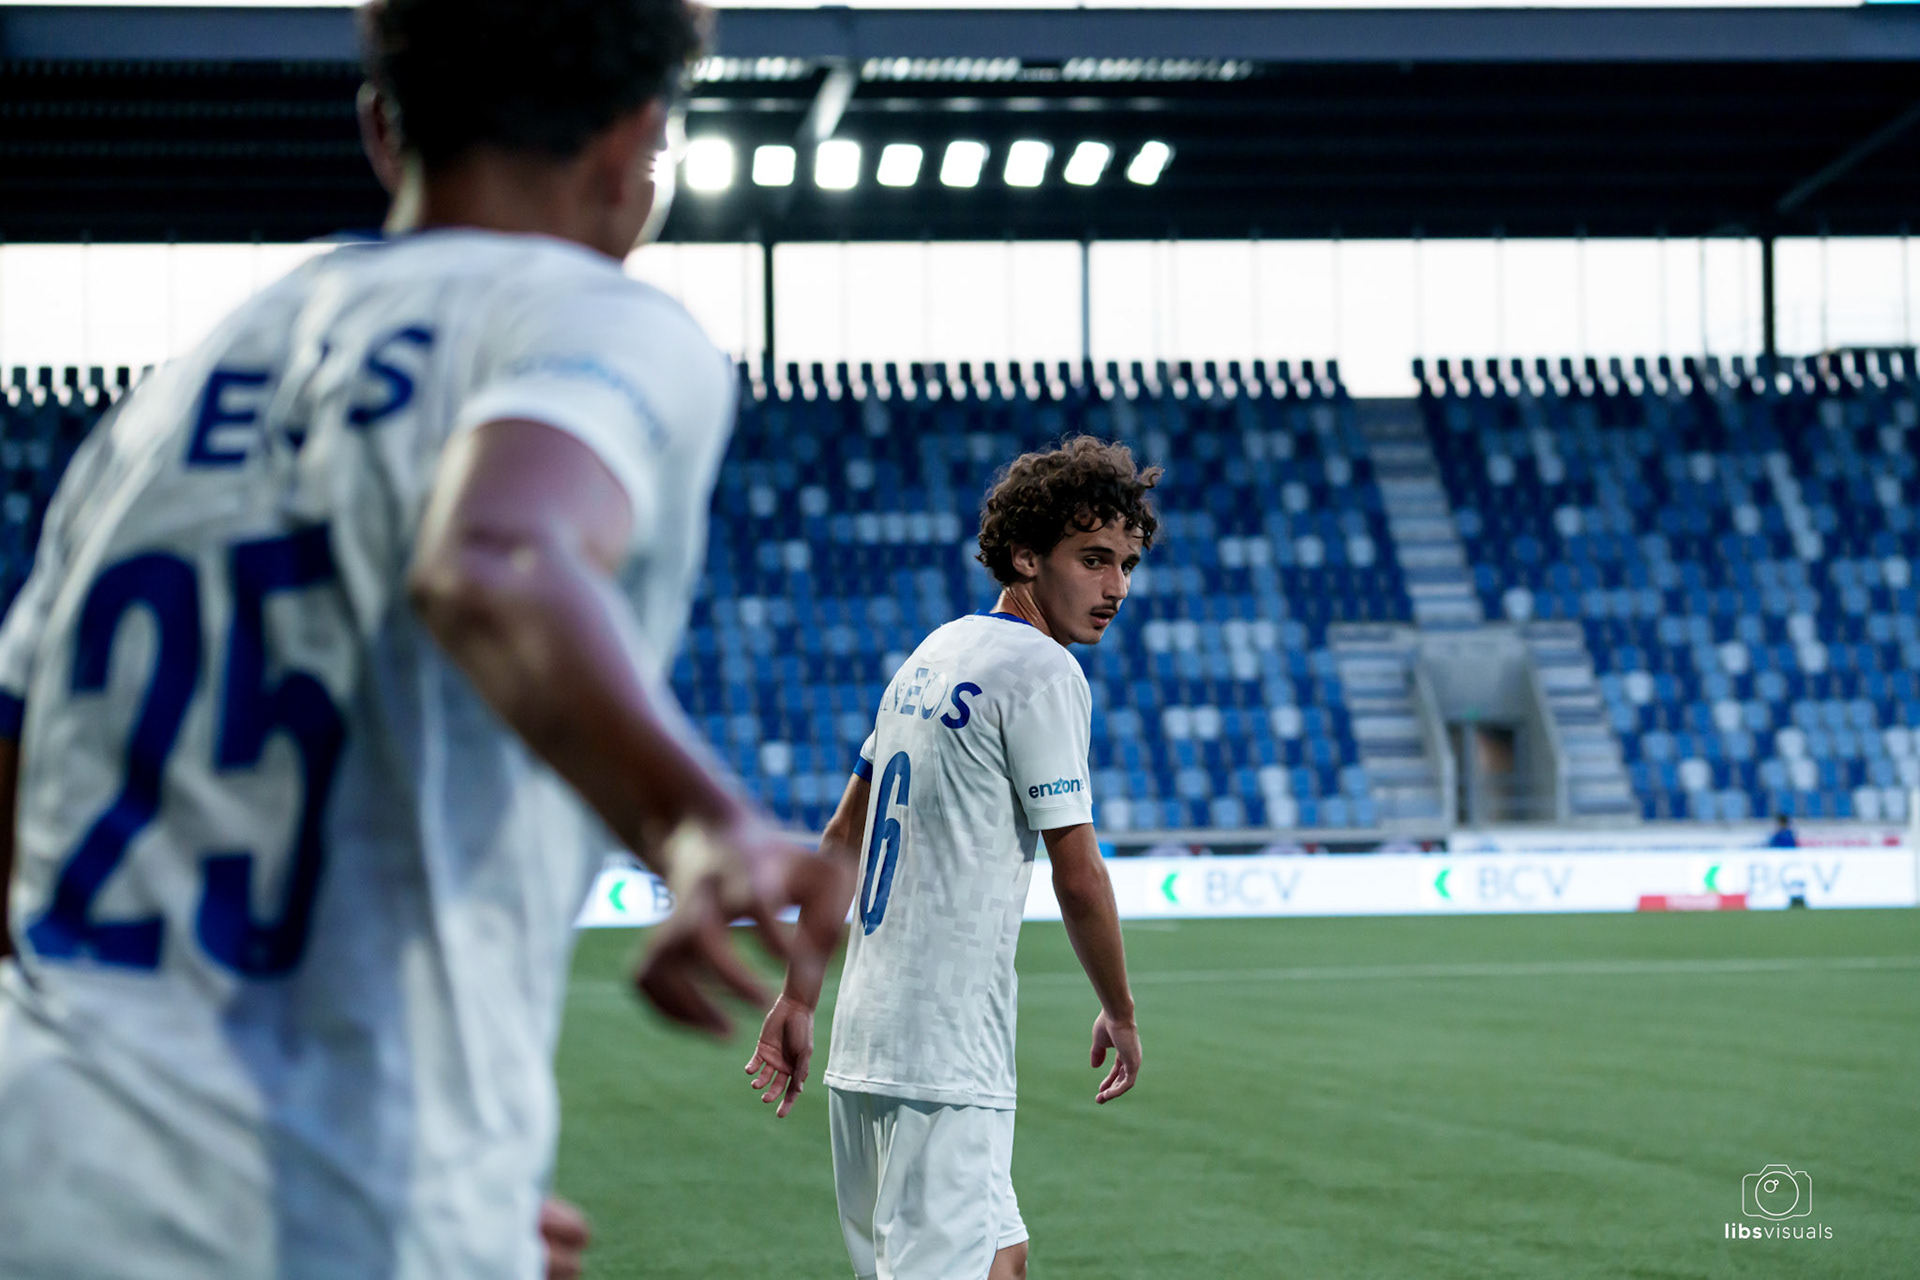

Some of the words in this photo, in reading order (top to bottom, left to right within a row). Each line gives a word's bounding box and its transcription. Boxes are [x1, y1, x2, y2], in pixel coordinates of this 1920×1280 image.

[26, 523, 345, 977] 25
[860, 750, 911, 936] 6
[1205, 867, 1301, 905] BCV
[1477, 864, 1573, 901] BCV
